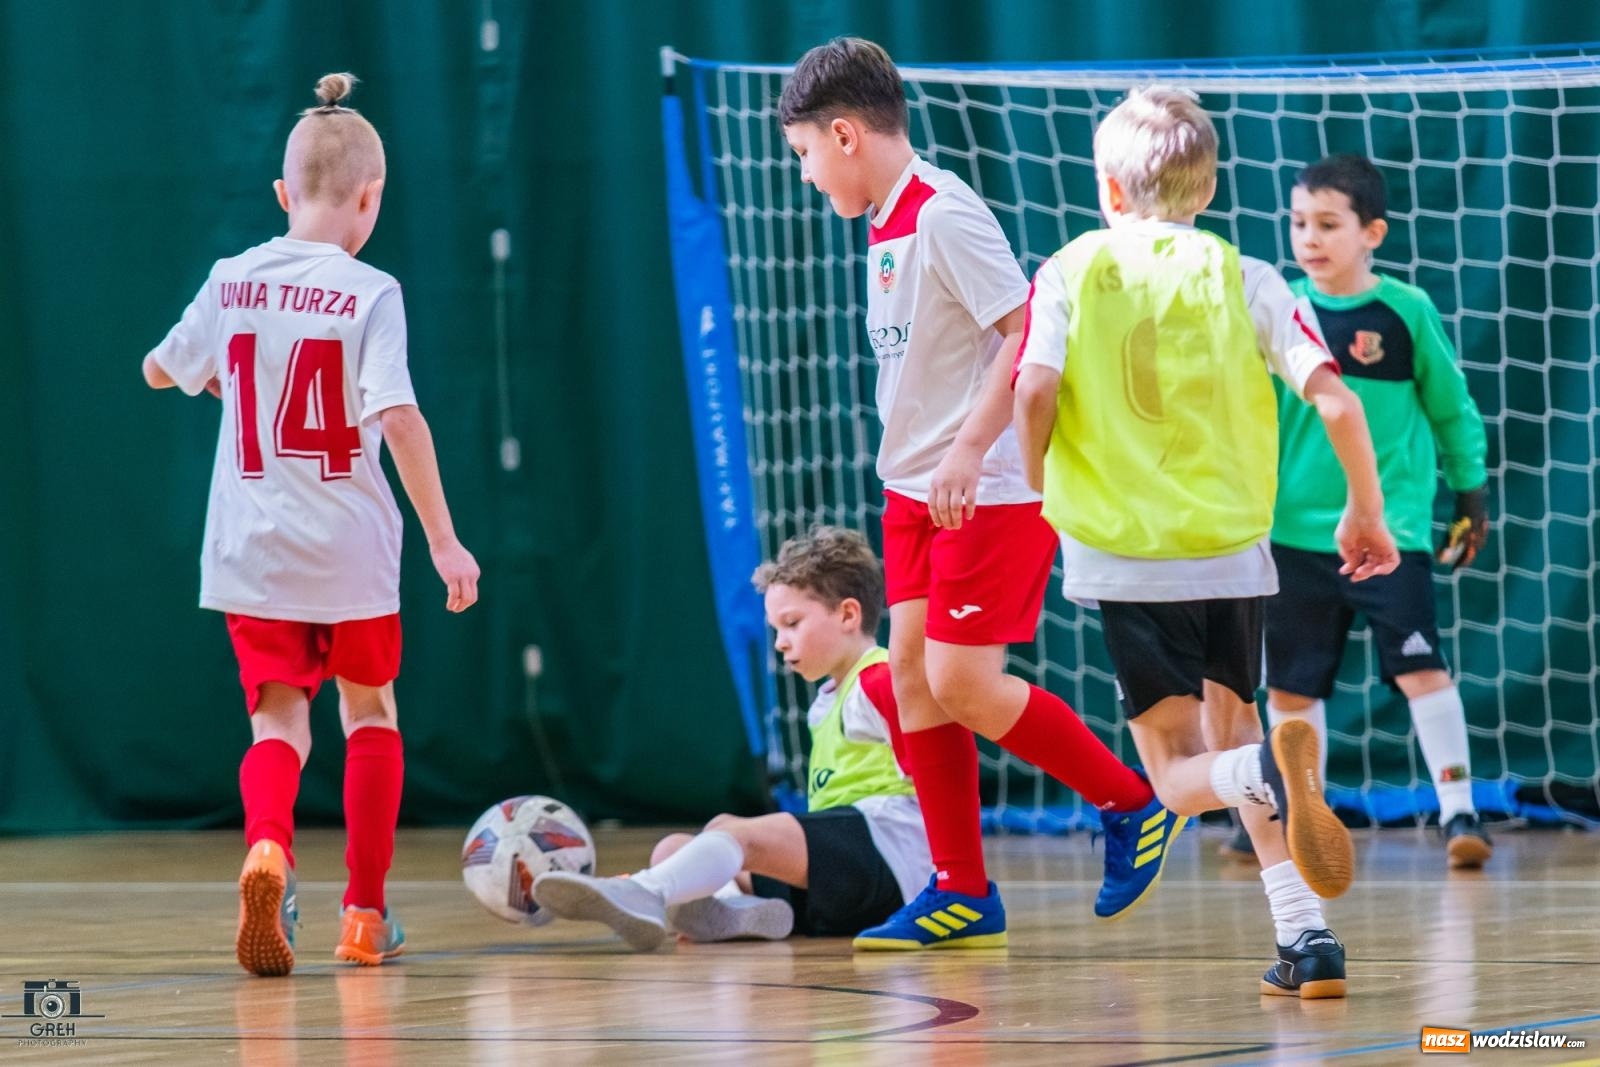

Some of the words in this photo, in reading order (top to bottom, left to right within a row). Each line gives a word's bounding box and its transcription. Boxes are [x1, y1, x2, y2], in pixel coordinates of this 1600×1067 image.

[220, 281, 268, 311] UNIA
[278, 284, 357, 320] TURZA
[227, 333, 362, 482] 14
